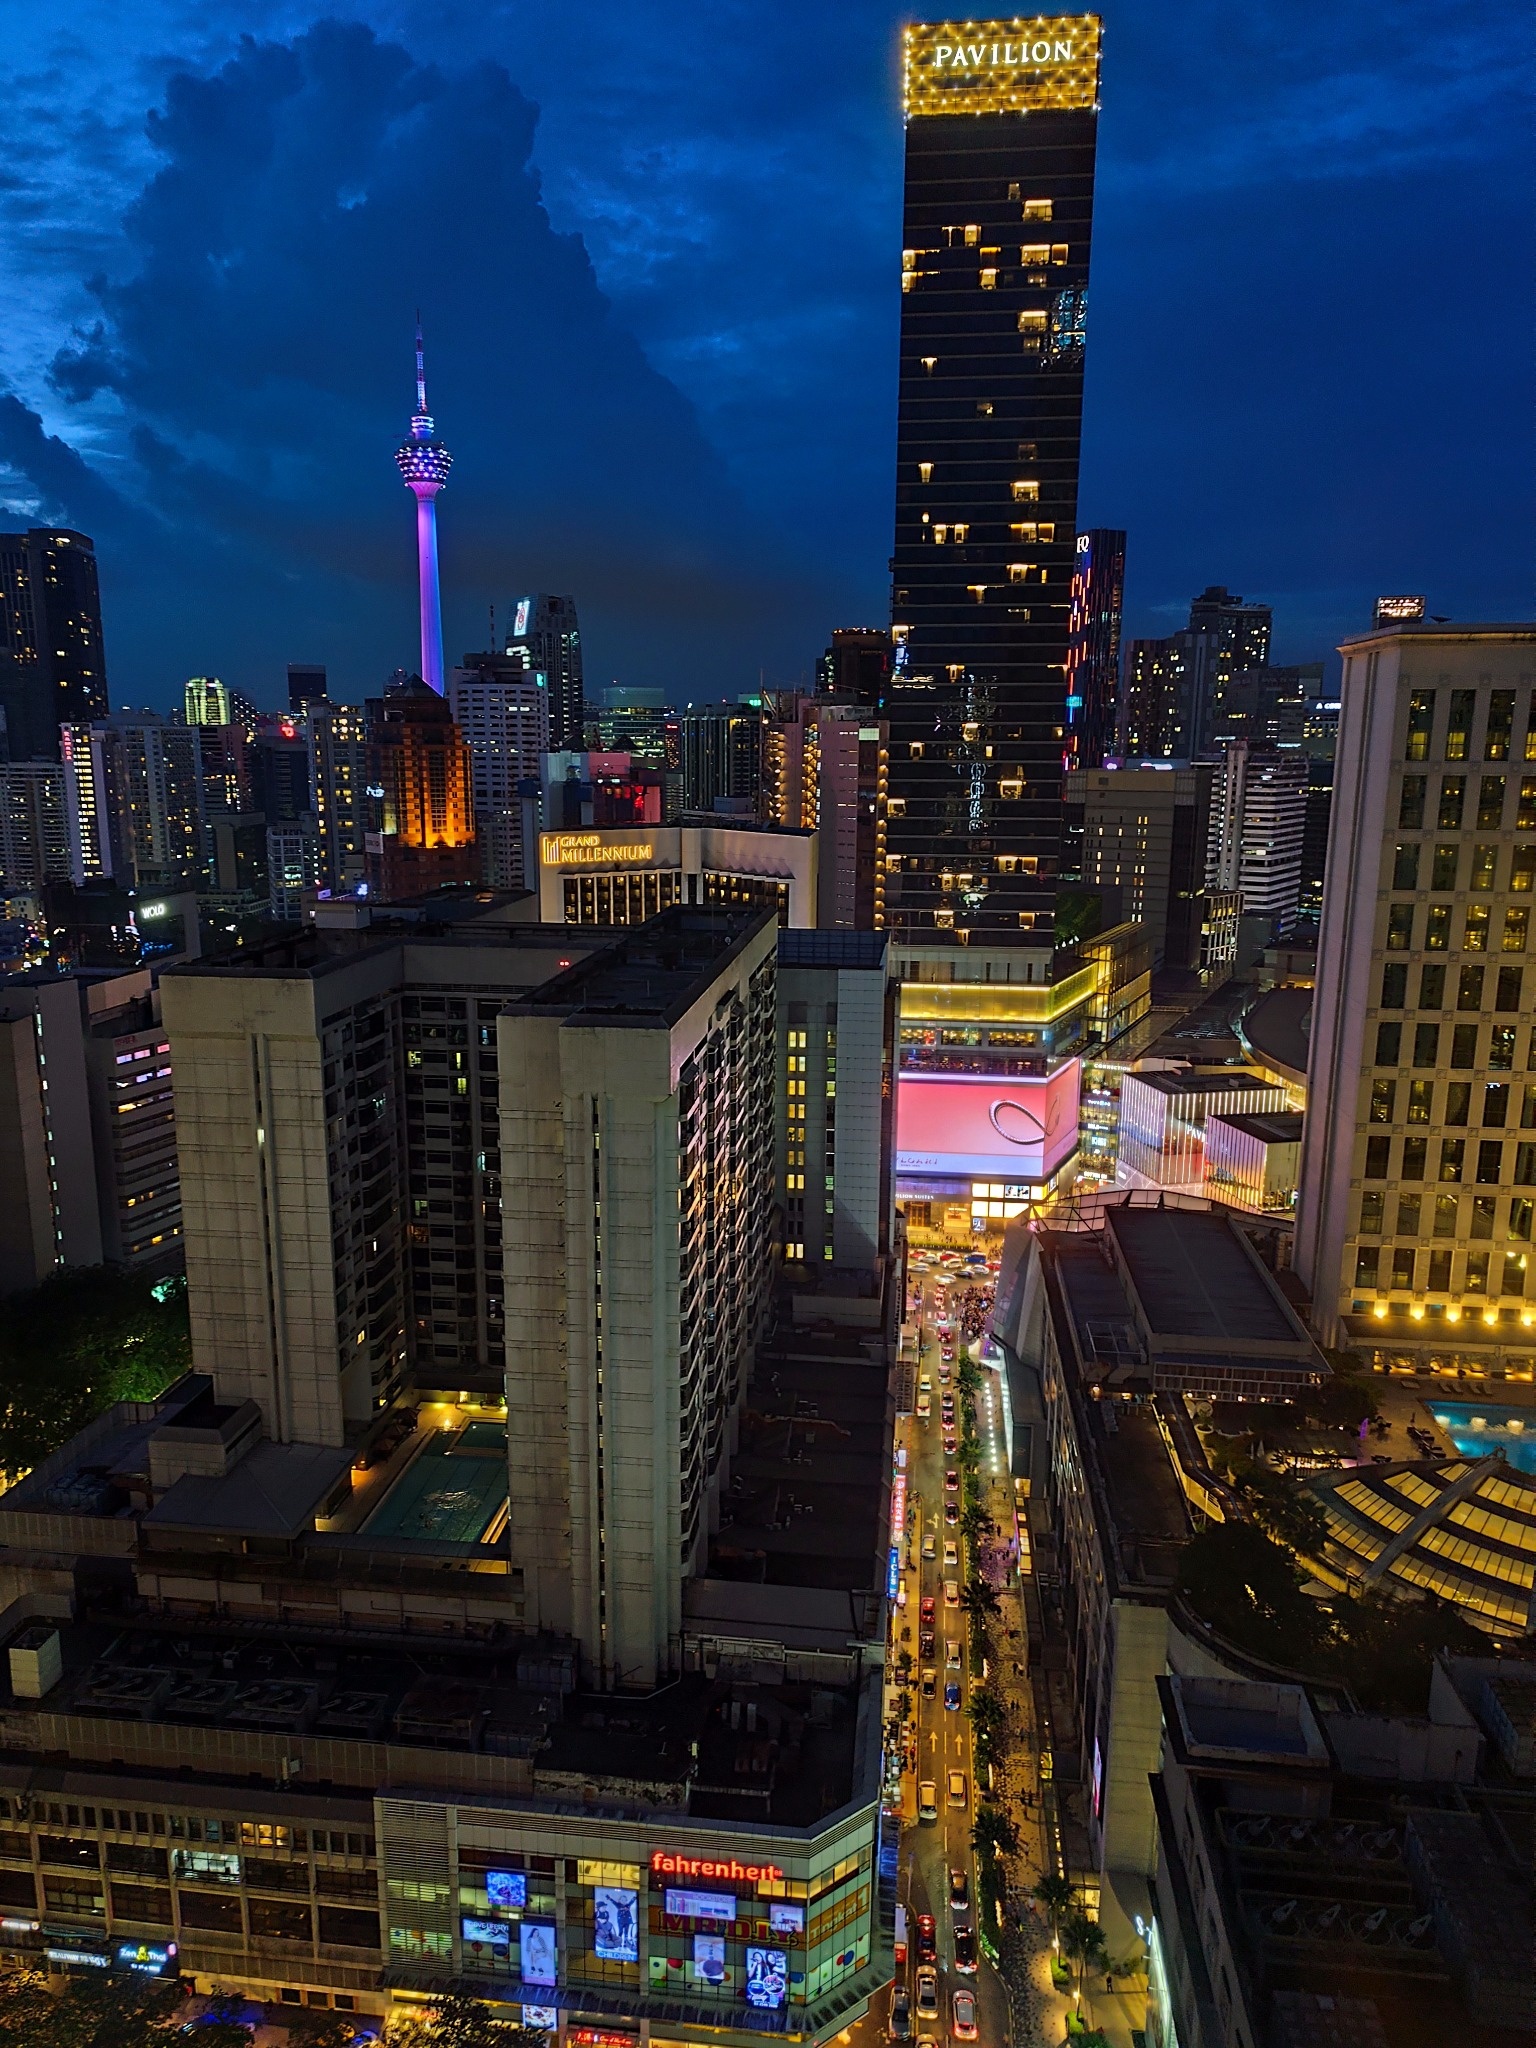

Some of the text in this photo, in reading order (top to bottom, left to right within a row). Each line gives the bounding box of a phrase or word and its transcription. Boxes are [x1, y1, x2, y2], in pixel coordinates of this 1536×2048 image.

[935, 40, 1074, 67] PAVILION
[1077, 536, 1089, 553] EQ
[561, 837, 599, 847] GRAND
[561, 845, 652, 863] MILLENNIUM
[858, 1887, 867, 1910] 1
[120, 1948, 137, 1958] Zen
[597, 1951, 635, 1961] CHILDREN
